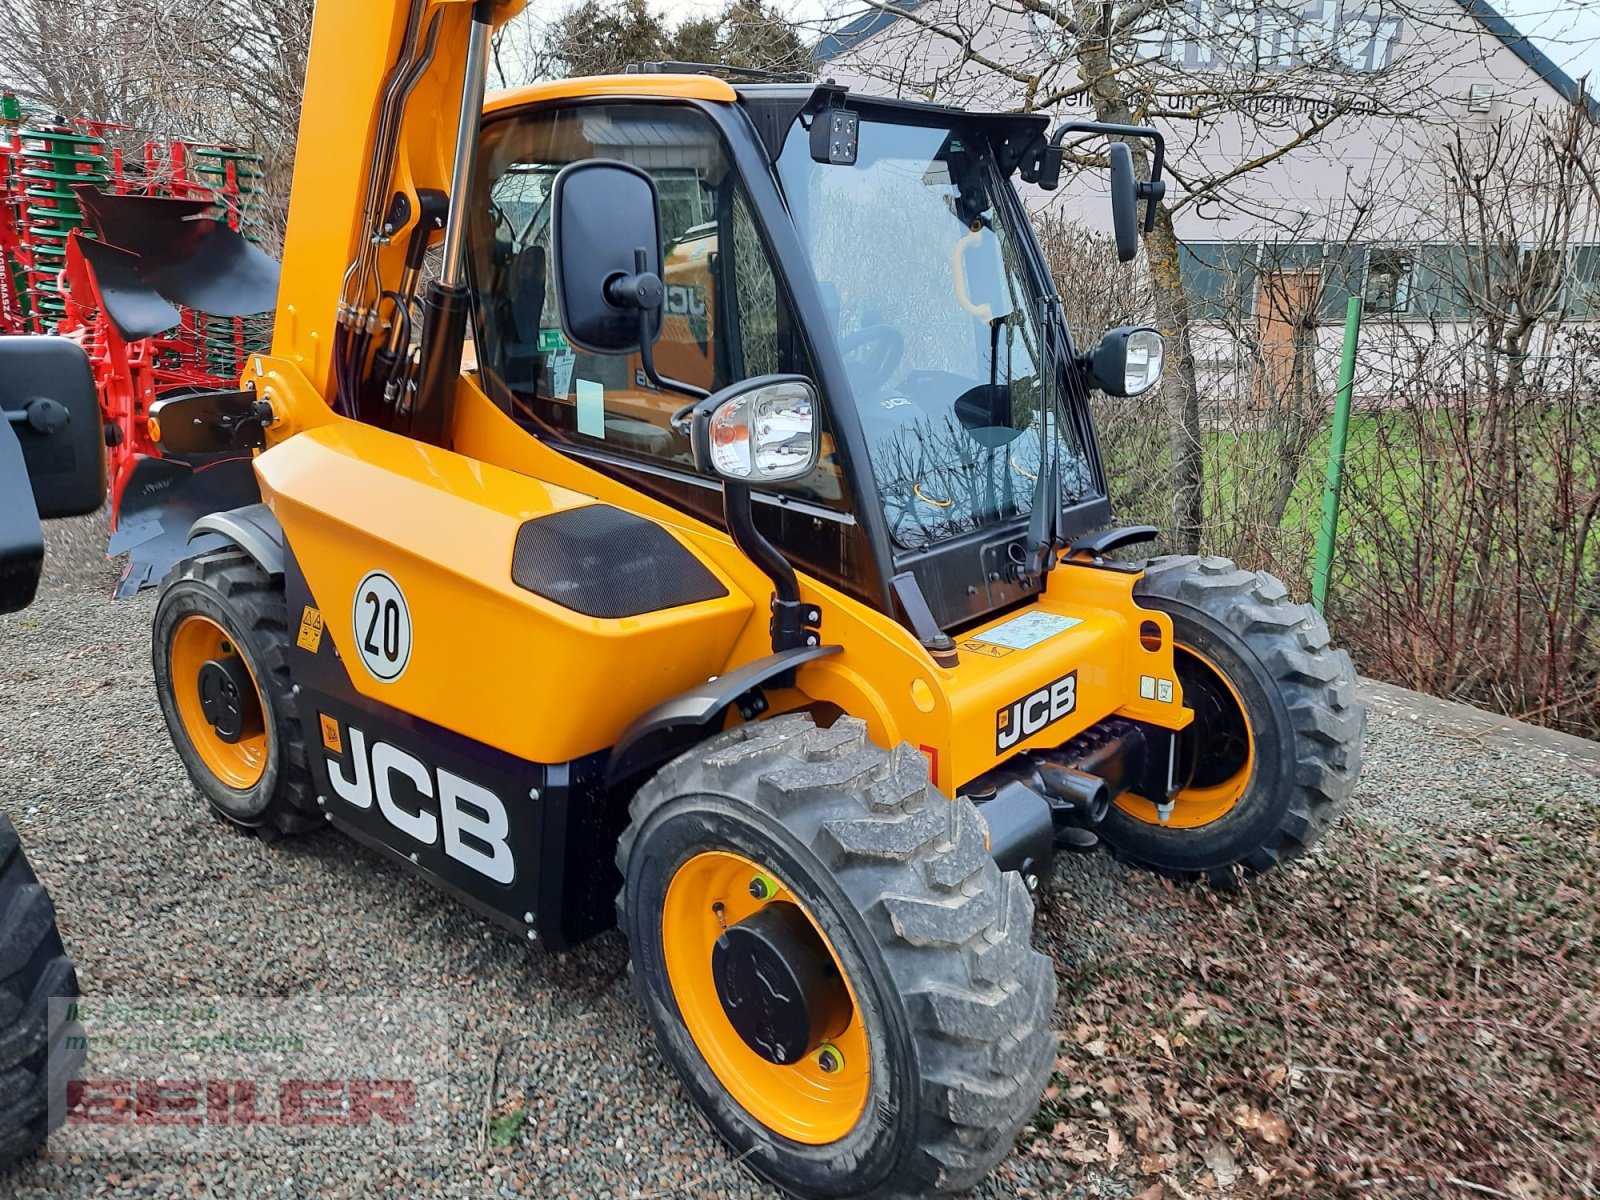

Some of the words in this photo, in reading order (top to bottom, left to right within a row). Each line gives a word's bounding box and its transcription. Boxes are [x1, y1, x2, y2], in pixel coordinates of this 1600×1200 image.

[364, 591, 399, 662] 20
[998, 675, 1075, 749] JCB
[326, 727, 515, 884] JCB
